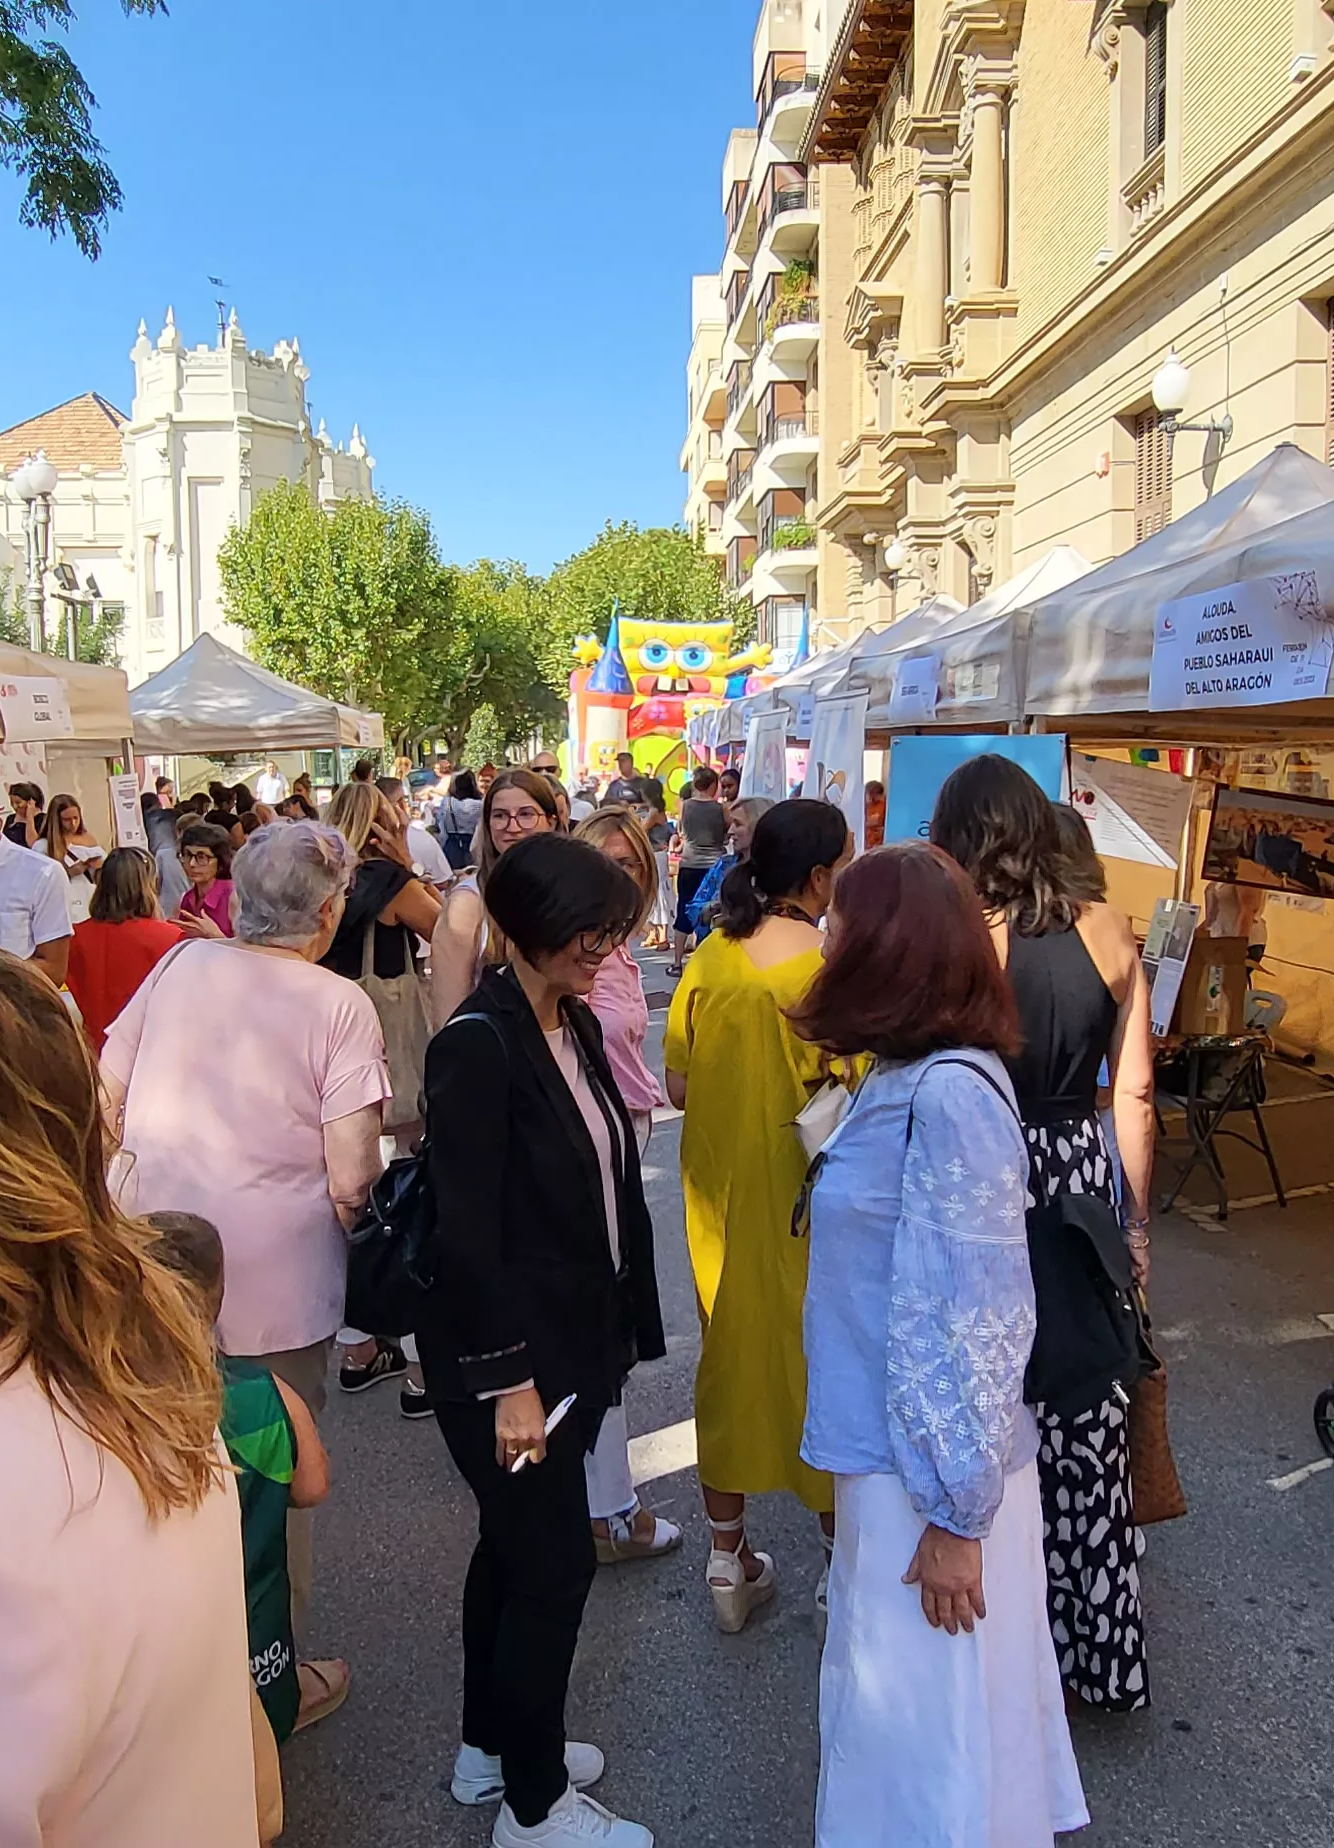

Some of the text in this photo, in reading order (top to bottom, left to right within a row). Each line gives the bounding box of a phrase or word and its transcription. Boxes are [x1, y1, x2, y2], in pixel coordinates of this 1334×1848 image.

[1195, 626, 1229, 646] AMIGOS
[1231, 624, 1253, 640] DEL
[1183, 647, 1274, 672] PUEBLO SAHARAUI
[1185, 671, 1273, 696] DEL ALTO ARAGÓN
